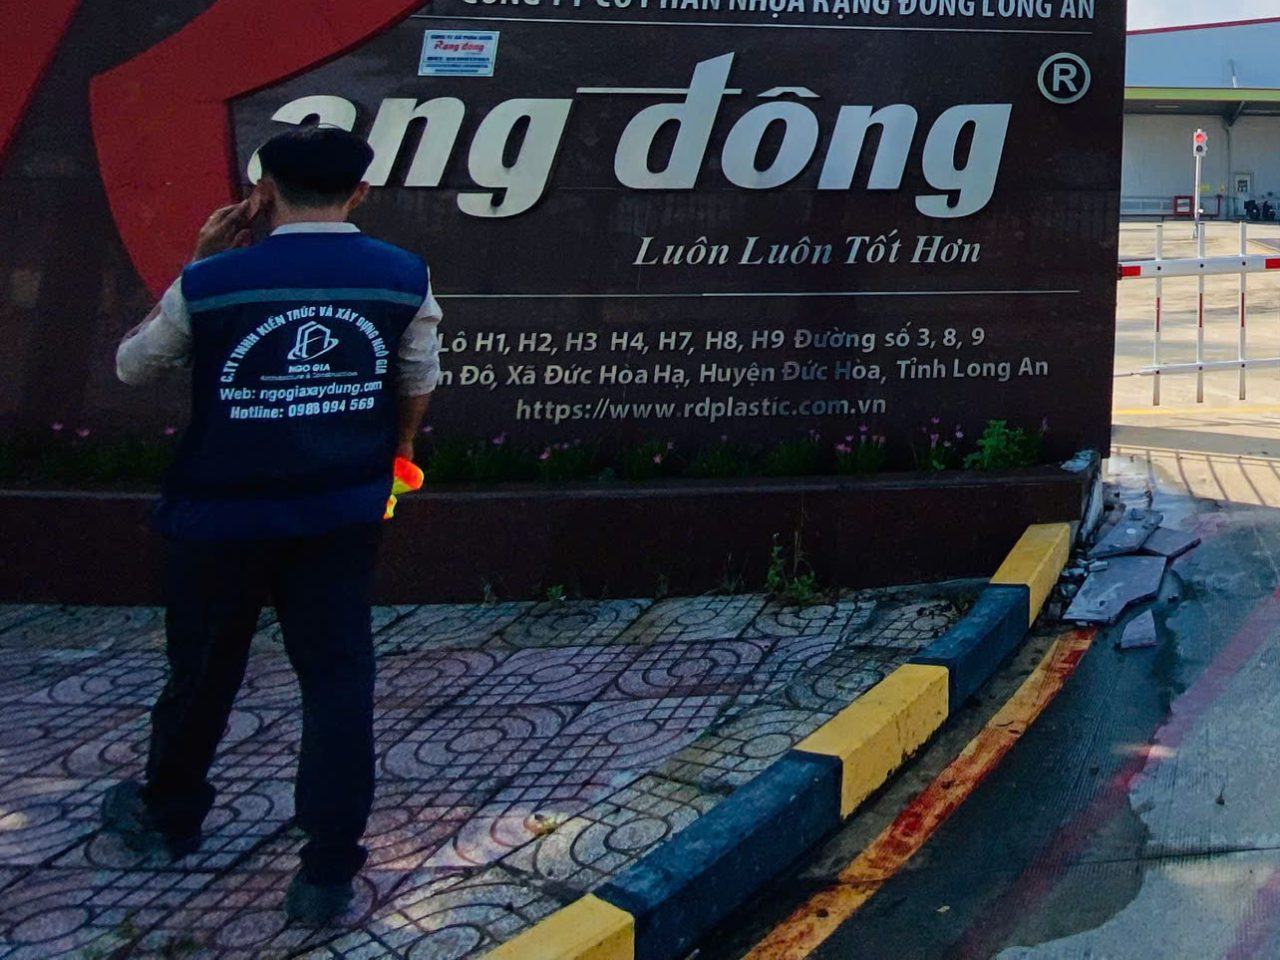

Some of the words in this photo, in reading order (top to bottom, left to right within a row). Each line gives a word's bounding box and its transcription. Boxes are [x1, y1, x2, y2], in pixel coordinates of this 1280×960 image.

[632, 235, 731, 266] Luôn
[738, 235, 834, 266] Luôn
[845, 229, 903, 265] Tốt
[910, 234, 982, 264] Hơn
[230, 333, 261, 359] TNHH
[286, 305, 317, 322] TRÚC
[375, 358, 388, 375] GIA
[438, 331, 468, 353] Lô
[474, 332, 511, 356] H1,
[517, 332, 559, 356] H2,
[565, 331, 599, 353] H3
[609, 331, 650, 356] H4,
[658, 330, 696, 355] H7,
[705, 330, 744, 354] H8,
[751, 329, 785, 350] H9
[793, 326, 876, 353] Đường
[884, 321, 912, 348] số
[917, 327, 937, 350] 3,
[942, 327, 963, 350] 8,
[971, 326, 986, 346] 9
[219, 387, 256, 401] Web:
[259, 380, 383, 402] ngogiaxaydung.com
[459, 363, 498, 391] Đô,
[505, 363, 537, 385] Xã
[544, 362, 593, 386] Đức
[599, 362, 648, 385] Hòa
[652, 363, 690, 389] Hạ,
[699, 362, 776, 388] Huyện
[781, 360, 829, 382] Đức
[834, 359, 888, 385] Hòa,
[896, 357, 946, 379] Tỉnh
[952, 358, 1012, 382] Long
[1017, 356, 1049, 377] An
[230, 405, 285, 420] Hotline:
[349, 396, 375, 411] 569
[515, 395, 887, 425] https://www.rdplastic.com.vn
